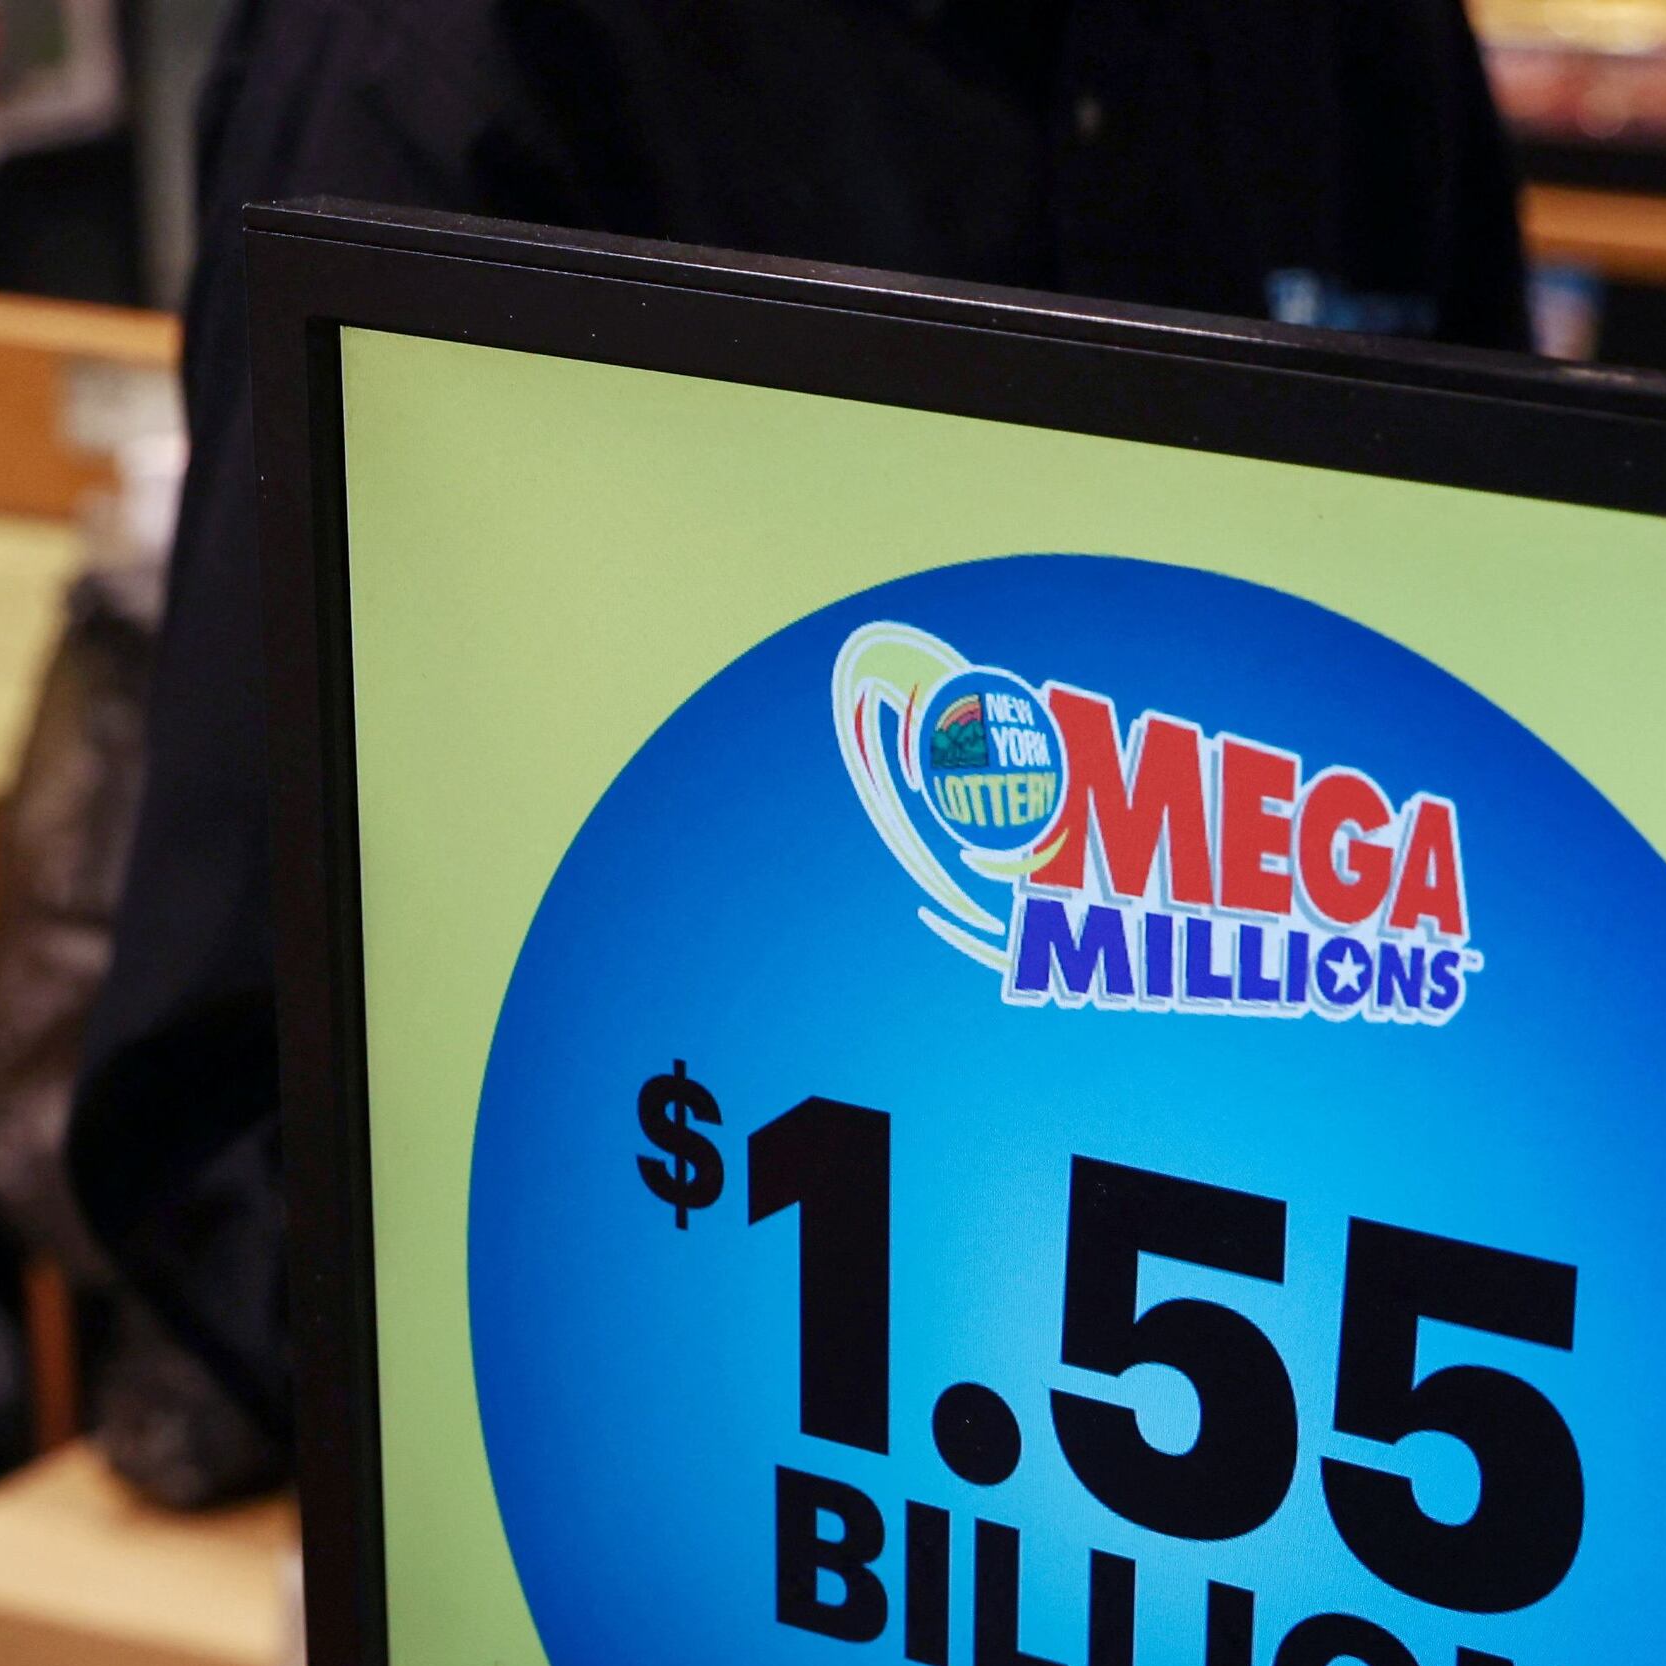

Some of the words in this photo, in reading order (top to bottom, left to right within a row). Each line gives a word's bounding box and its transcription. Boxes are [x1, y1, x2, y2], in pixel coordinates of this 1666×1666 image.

[984, 692, 1034, 727] NEW
[990, 727, 1052, 768] YORK
[934, 771, 1056, 827] LOTTERY
[1029, 687, 1464, 937] MEGA
[1014, 897, 1461, 1011] MILLIONS
[636, 1060, 1587, 1615] $1.55
